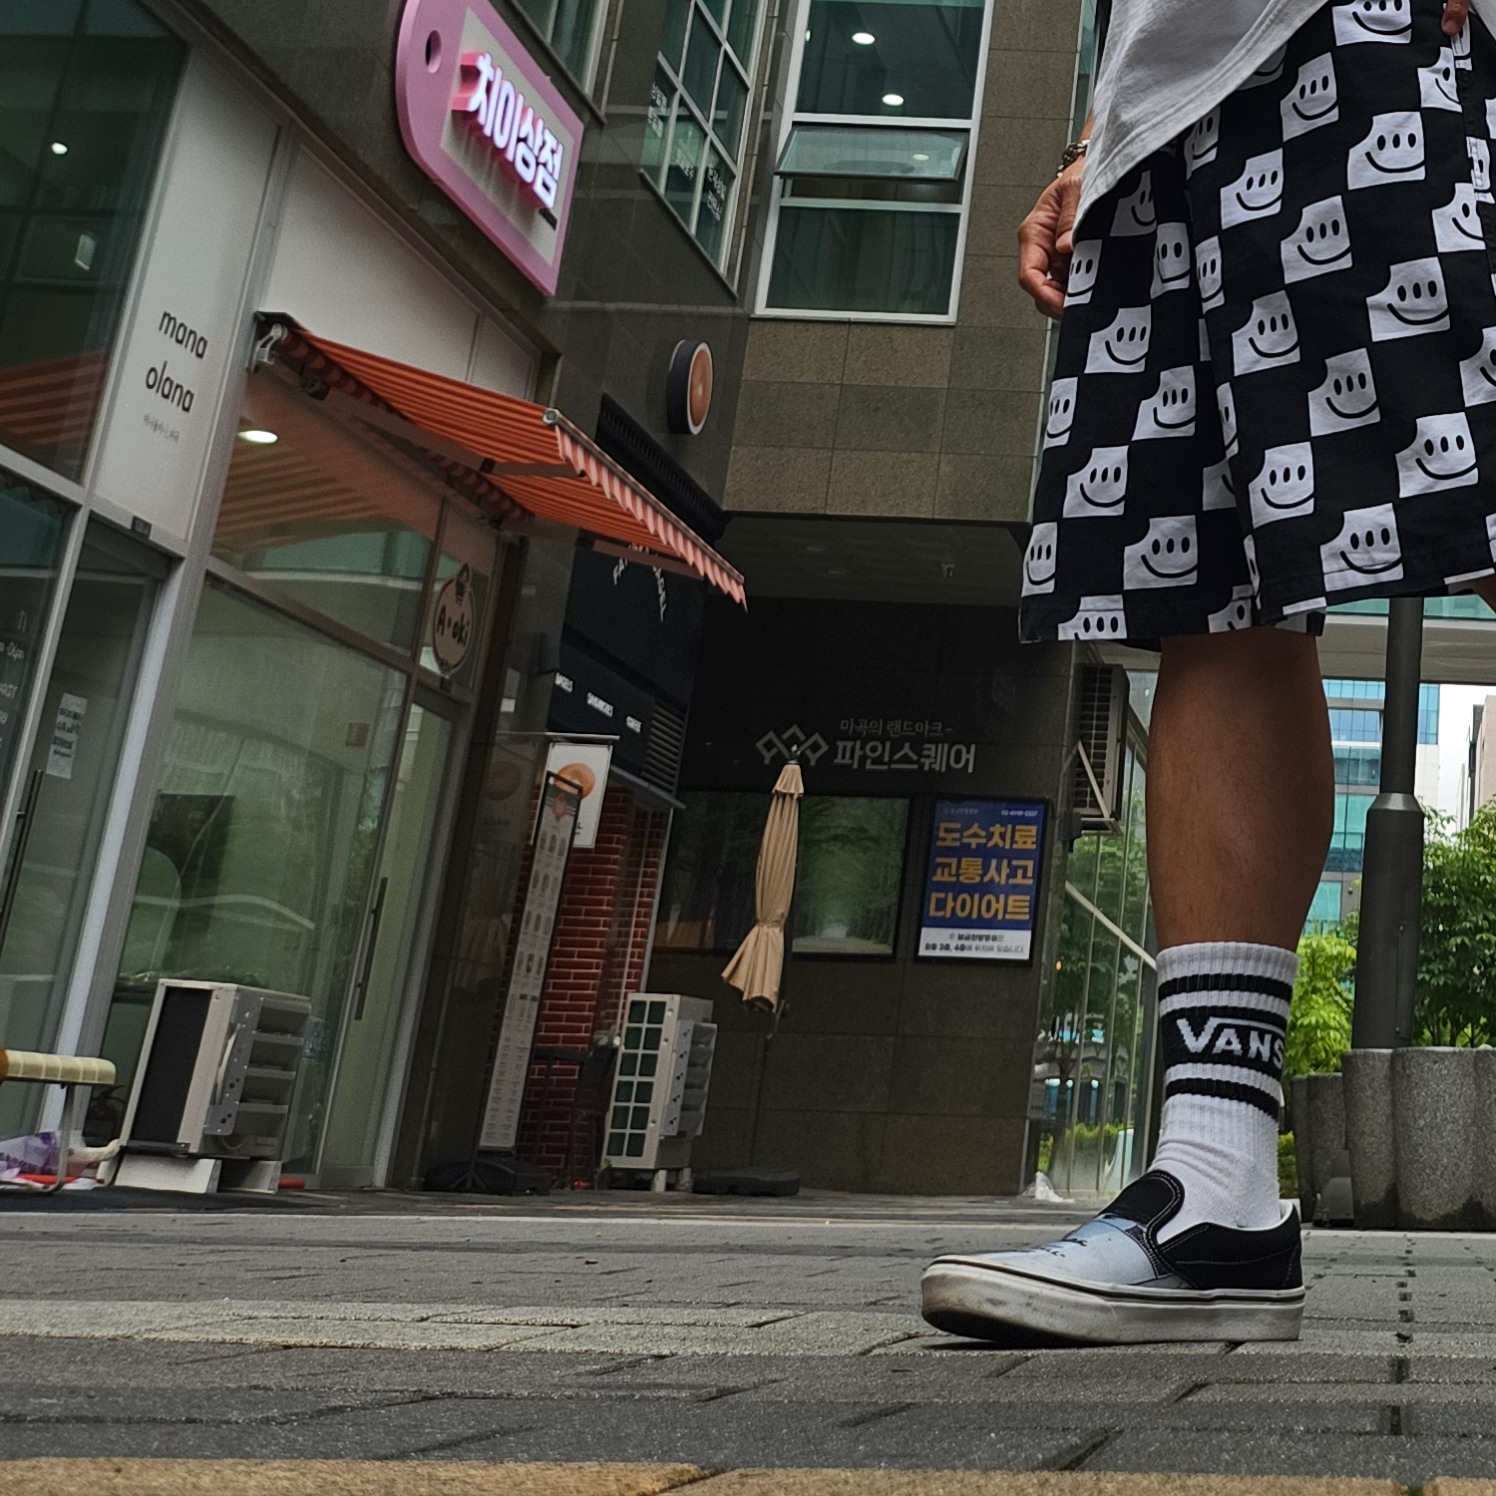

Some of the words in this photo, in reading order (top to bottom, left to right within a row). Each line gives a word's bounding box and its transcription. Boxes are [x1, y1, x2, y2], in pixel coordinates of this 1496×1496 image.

[467, 52, 563, 208] 치이상점
[159, 311, 208, 359] mana
[146, 361, 194, 413] olana
[841, 718, 882, 736] 마곡의
[833, 740, 976, 773] 파인스퀘어
[936, 822, 1038, 850] 도수치료
[932, 857, 1034, 885] 교통사고
[929, 892, 1030, 920] 다이어트
[1176, 1016, 1285, 1069] VANS
